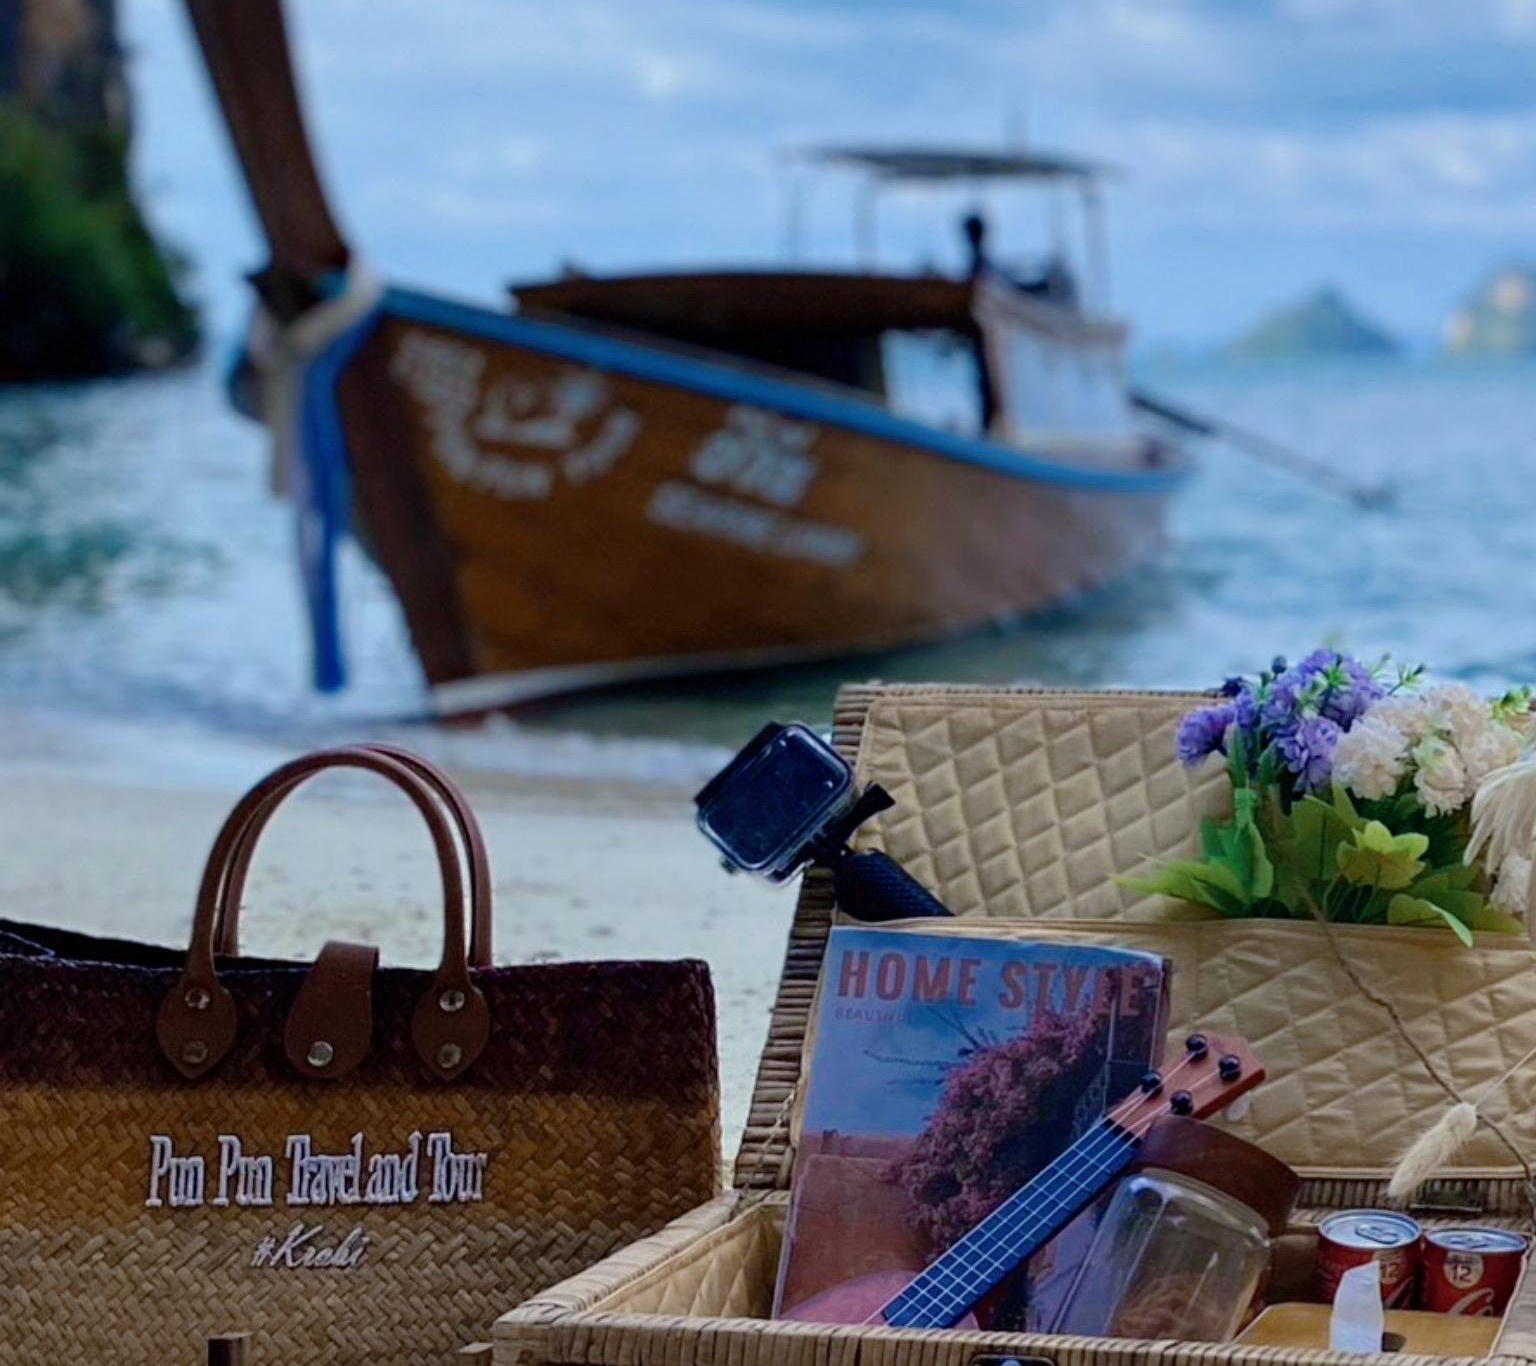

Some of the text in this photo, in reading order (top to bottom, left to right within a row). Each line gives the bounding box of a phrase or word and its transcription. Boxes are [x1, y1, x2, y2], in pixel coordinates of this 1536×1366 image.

[838, 950, 1151, 1019] HOME STYLE
[145, 1130, 488, 1207] Pun Pun Travel and Tour
[250, 1222, 370, 1269] #Krabi
